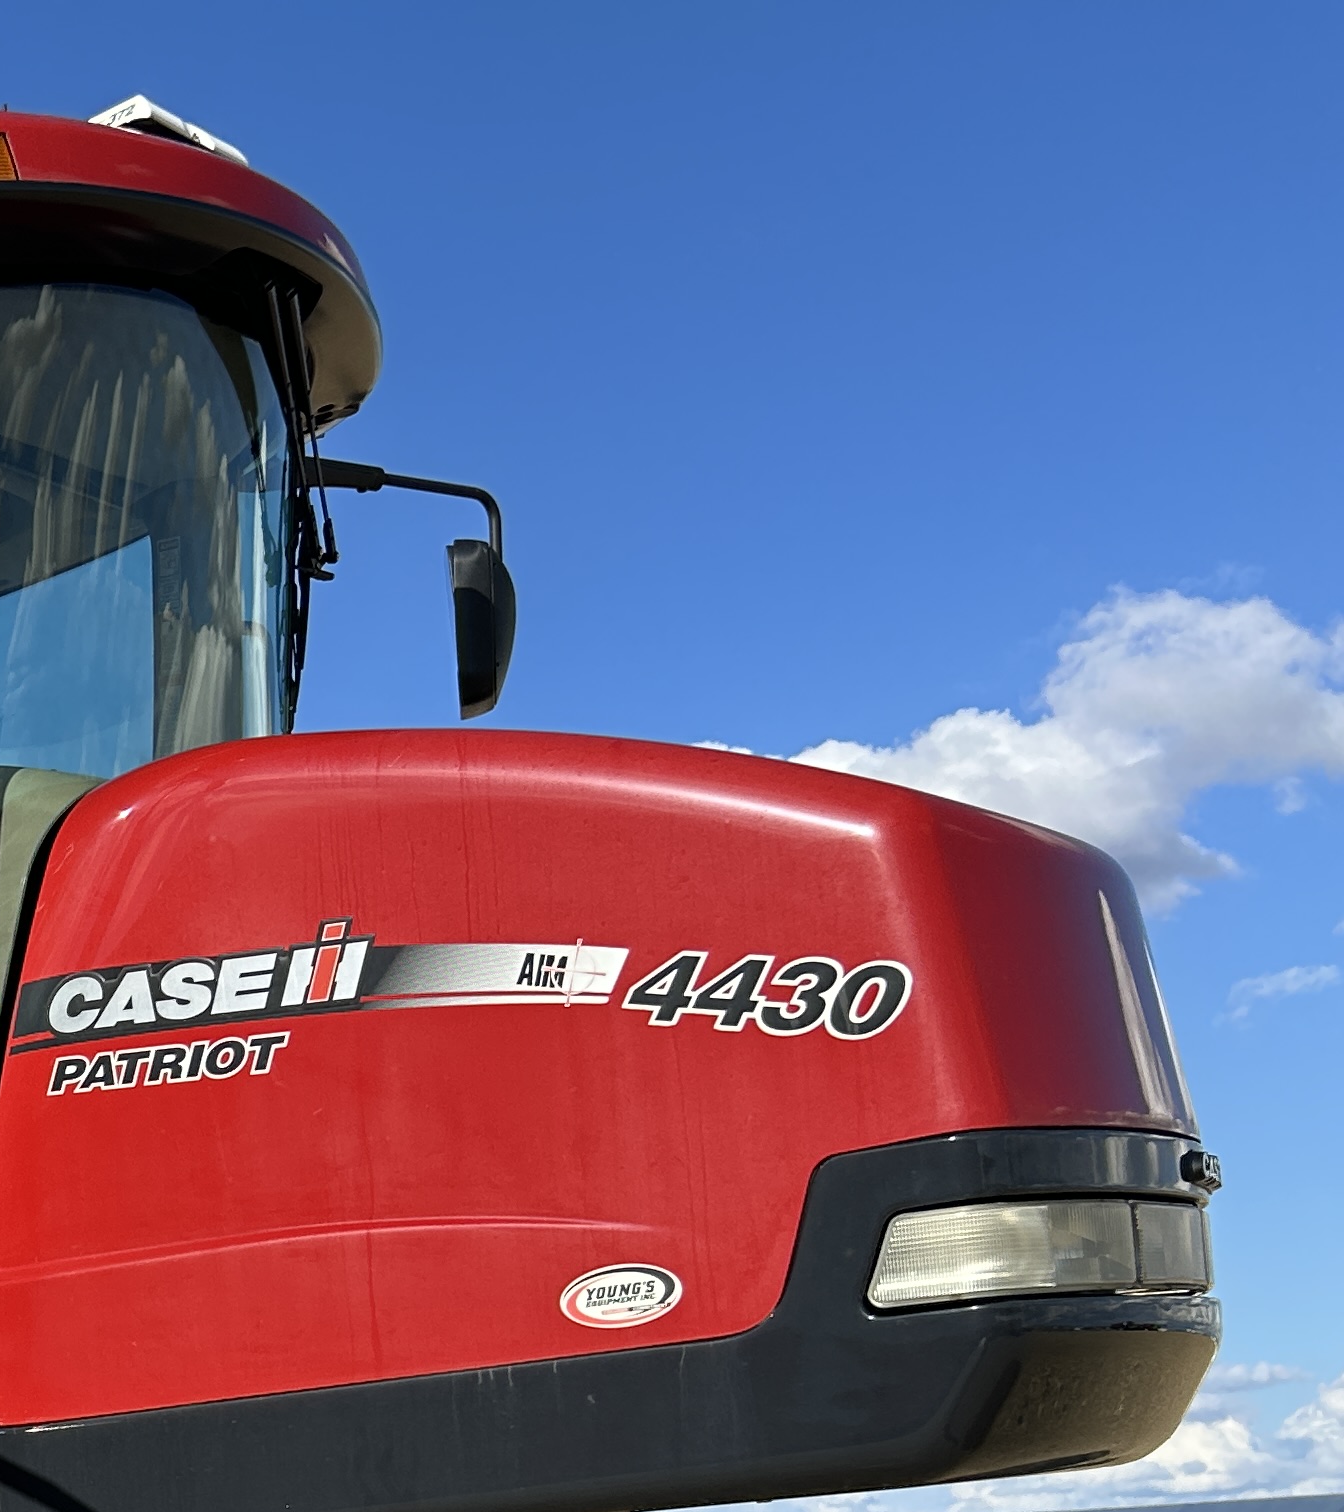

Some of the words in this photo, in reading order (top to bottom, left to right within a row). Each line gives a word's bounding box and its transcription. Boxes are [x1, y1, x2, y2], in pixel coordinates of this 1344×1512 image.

[48, 953, 277, 1033] CASE
[623, 951, 912, 1040] 4430
[47, 1031, 290, 1096] PATRIOT
[585, 1295, 639, 1308] EQUIPMENT
[586, 1280, 656, 1301] YOUNG'S
